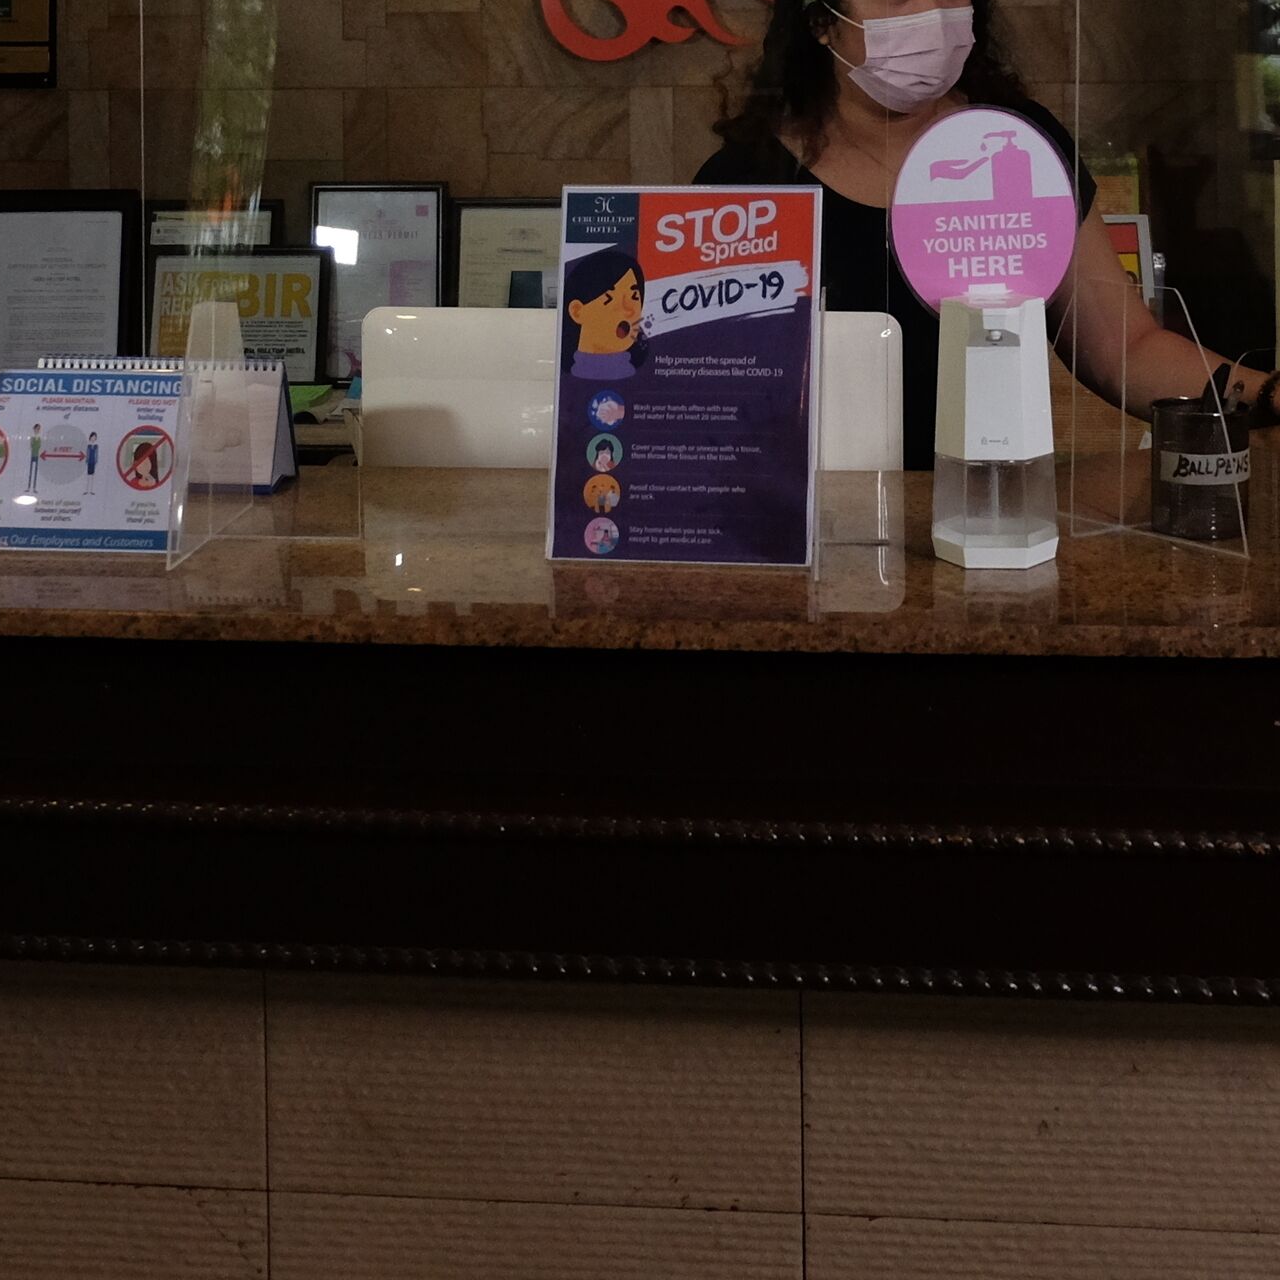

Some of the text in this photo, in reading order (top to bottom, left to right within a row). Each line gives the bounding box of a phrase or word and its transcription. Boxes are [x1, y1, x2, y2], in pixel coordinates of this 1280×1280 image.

[597, 215, 636, 224] HILLTOP
[935, 212, 1033, 233] SANITIZE
[586, 225, 620, 234] HOTEL
[655, 199, 777, 252] STOP
[700, 231, 778, 264] Spread
[923, 232, 1048, 254] YOUR HANDS
[947, 254, 1024, 278] HERE
[238, 273, 312, 318] BIR
[661, 271, 784, 314] COVID-19
[655, 355, 756, 366] Help prevent the spread of
[654, 366, 783, 378] respiratory diseases like COVID-19
[1, 378, 68, 393] SOCIAL
[72, 378, 182, 395] DISTANCING
[42, 404, 71, 412] minimum
[73, 404, 99, 412] distance
[633, 403, 738, 414] Wash your hands often with soap
[633, 412, 646, 420] and
[684, 412, 700, 421] least
[631, 443, 650, 452] Cover
[652, 444, 666, 453] your
[667, 443, 687, 453] cough
[720, 444, 734, 453] with
[631, 451, 646, 460] then
[667, 452, 678, 460] the
[706, 452, 718, 461] the
[629, 483, 746, 494] Avoid close contact with people who
[629, 525, 643, 536] Stay
[644, 525, 663, 534] home
[664, 526, 682, 535] when
[683, 527, 695, 536] you
[10, 534, 27, 545] Our
[30, 535, 81, 547] Employees
[82, 536, 100, 546] and
[103, 536, 154, 547] Customers
[629, 535, 650, 544] except
[659, 536, 670, 545] get
[671, 535, 696, 544] medical
